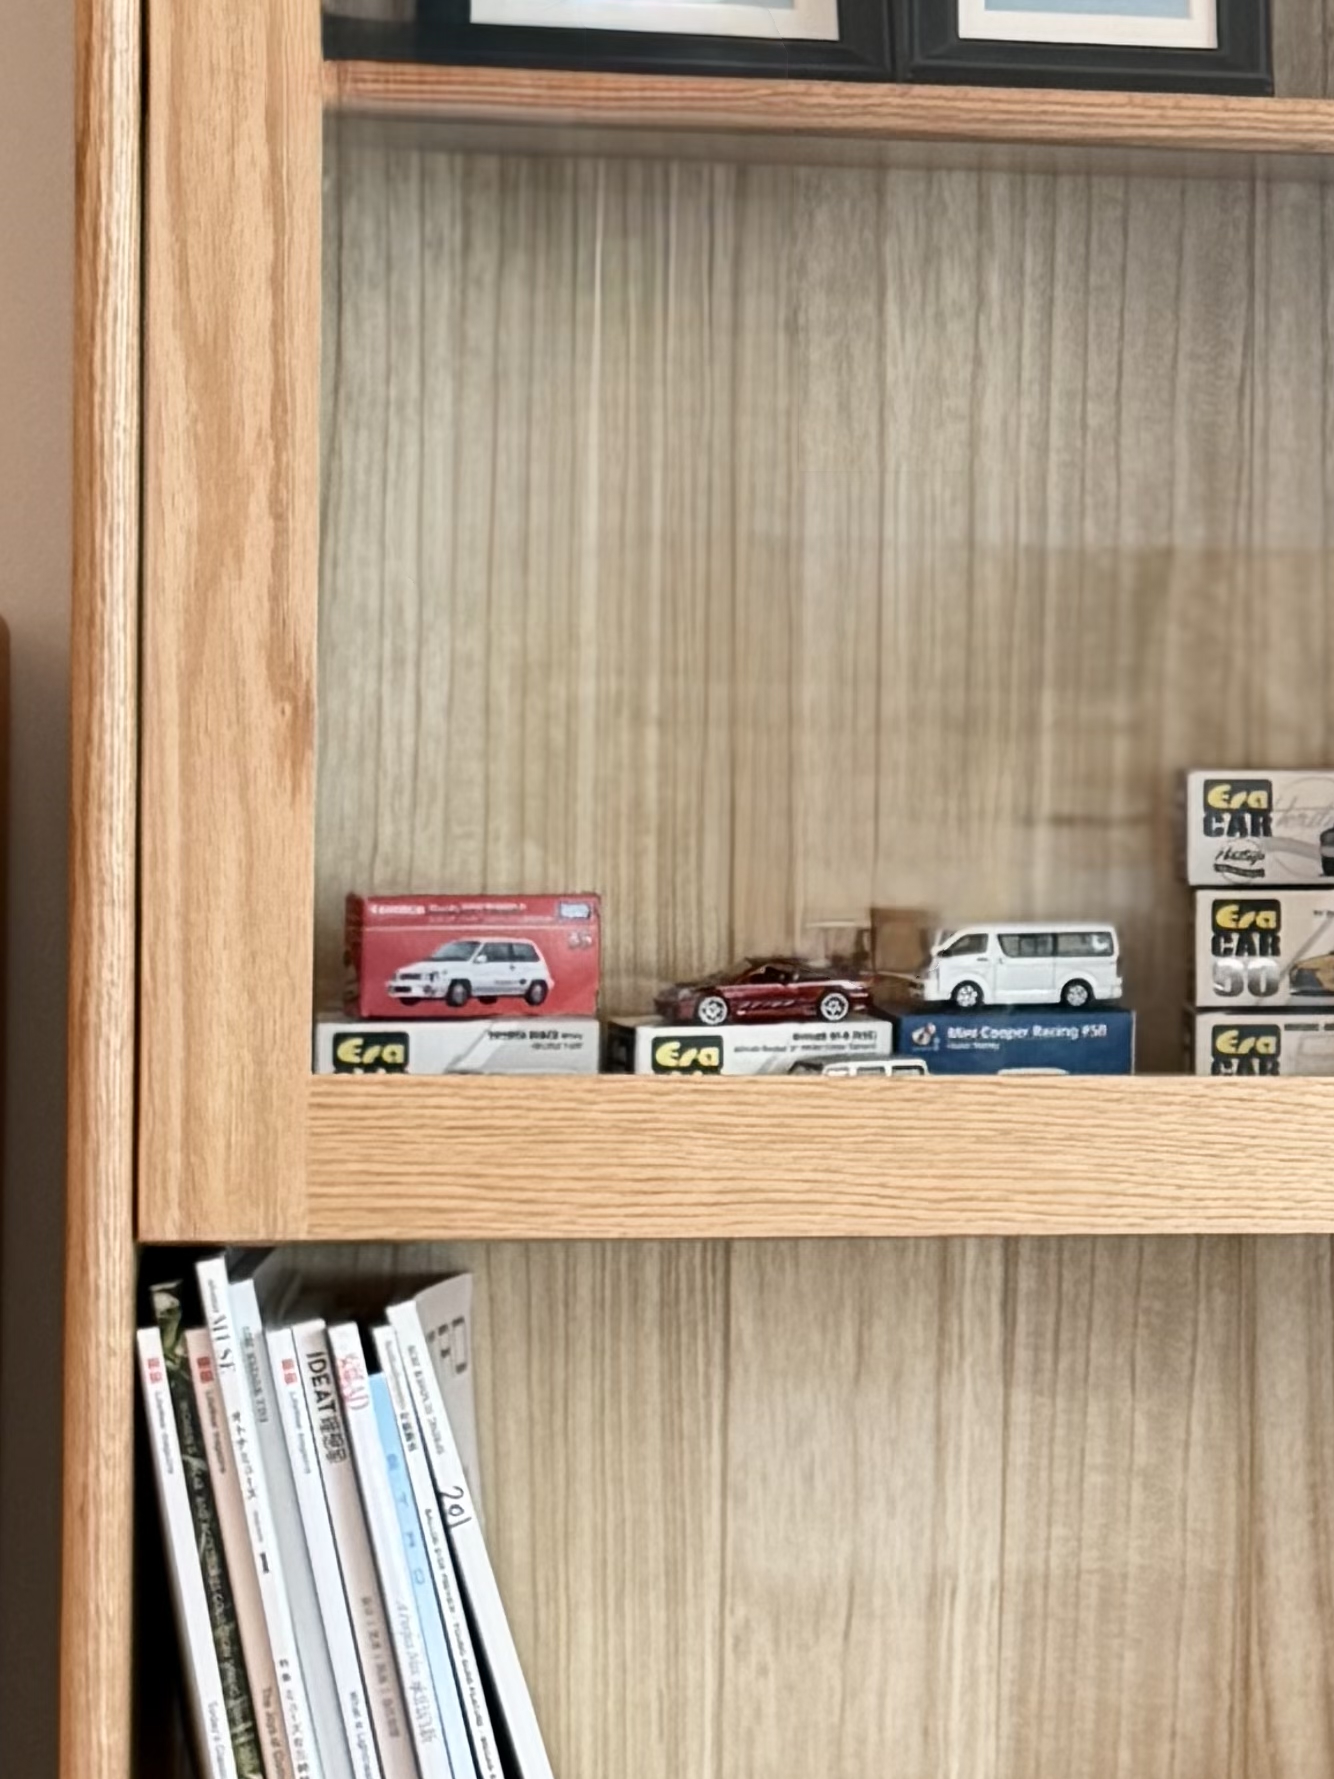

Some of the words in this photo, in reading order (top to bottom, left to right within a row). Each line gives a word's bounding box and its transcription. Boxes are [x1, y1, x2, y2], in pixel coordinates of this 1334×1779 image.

[1207, 783, 1268, 810] Era
[1203, 812, 1273, 838] CAR
[1215, 904, 1277, 929] Era
[1211, 933, 1282, 957] CAR
[980, 1025, 1027, 1042] Cooper
[1033, 1025, 1078, 1040] Racing
[1215, 1030, 1277, 1055] Era
[337, 1037, 405, 1064] Era
[655, 1041, 720, 1067] Era
[307, 1349, 338, 1415] IDEAT
[262, 1686, 276, 1707] The
